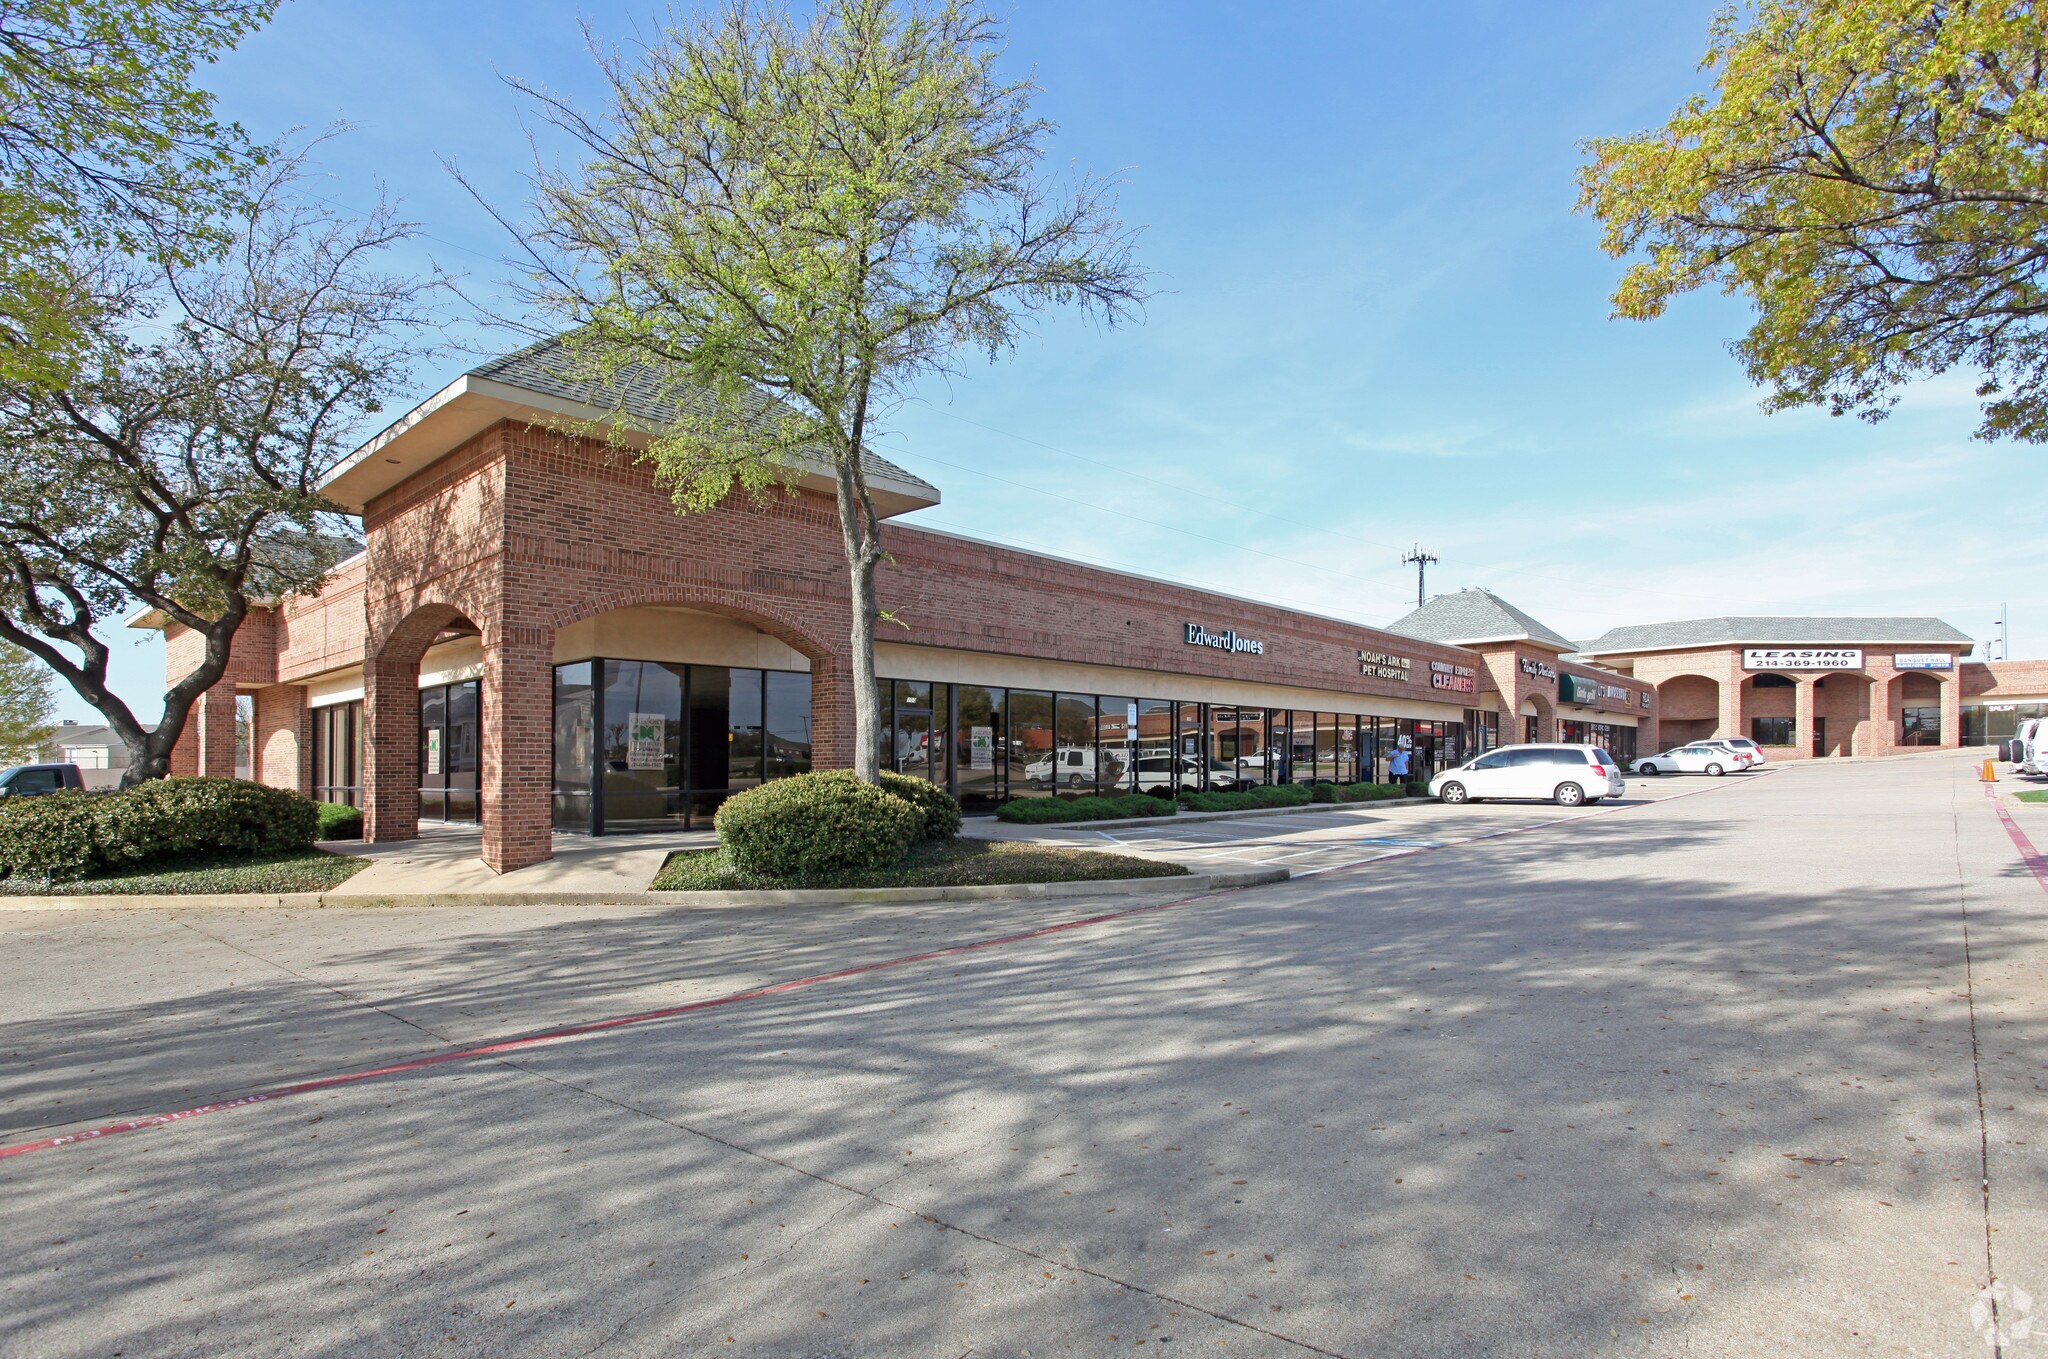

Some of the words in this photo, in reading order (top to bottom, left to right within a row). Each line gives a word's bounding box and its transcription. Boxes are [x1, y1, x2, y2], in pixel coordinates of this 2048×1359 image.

[1185, 622, 1231, 650] Edward
[1231, 631, 1264, 655] Jones
[1361, 650, 1387, 665] NOAH'S
[1388, 655, 1401, 668] ARK
[1521, 658, 1537, 680] Family
[1363, 664, 1376, 676] PET
[1377, 666, 1409, 681] HOSPITAL
[1432, 673, 1474, 693] CLEANERS
